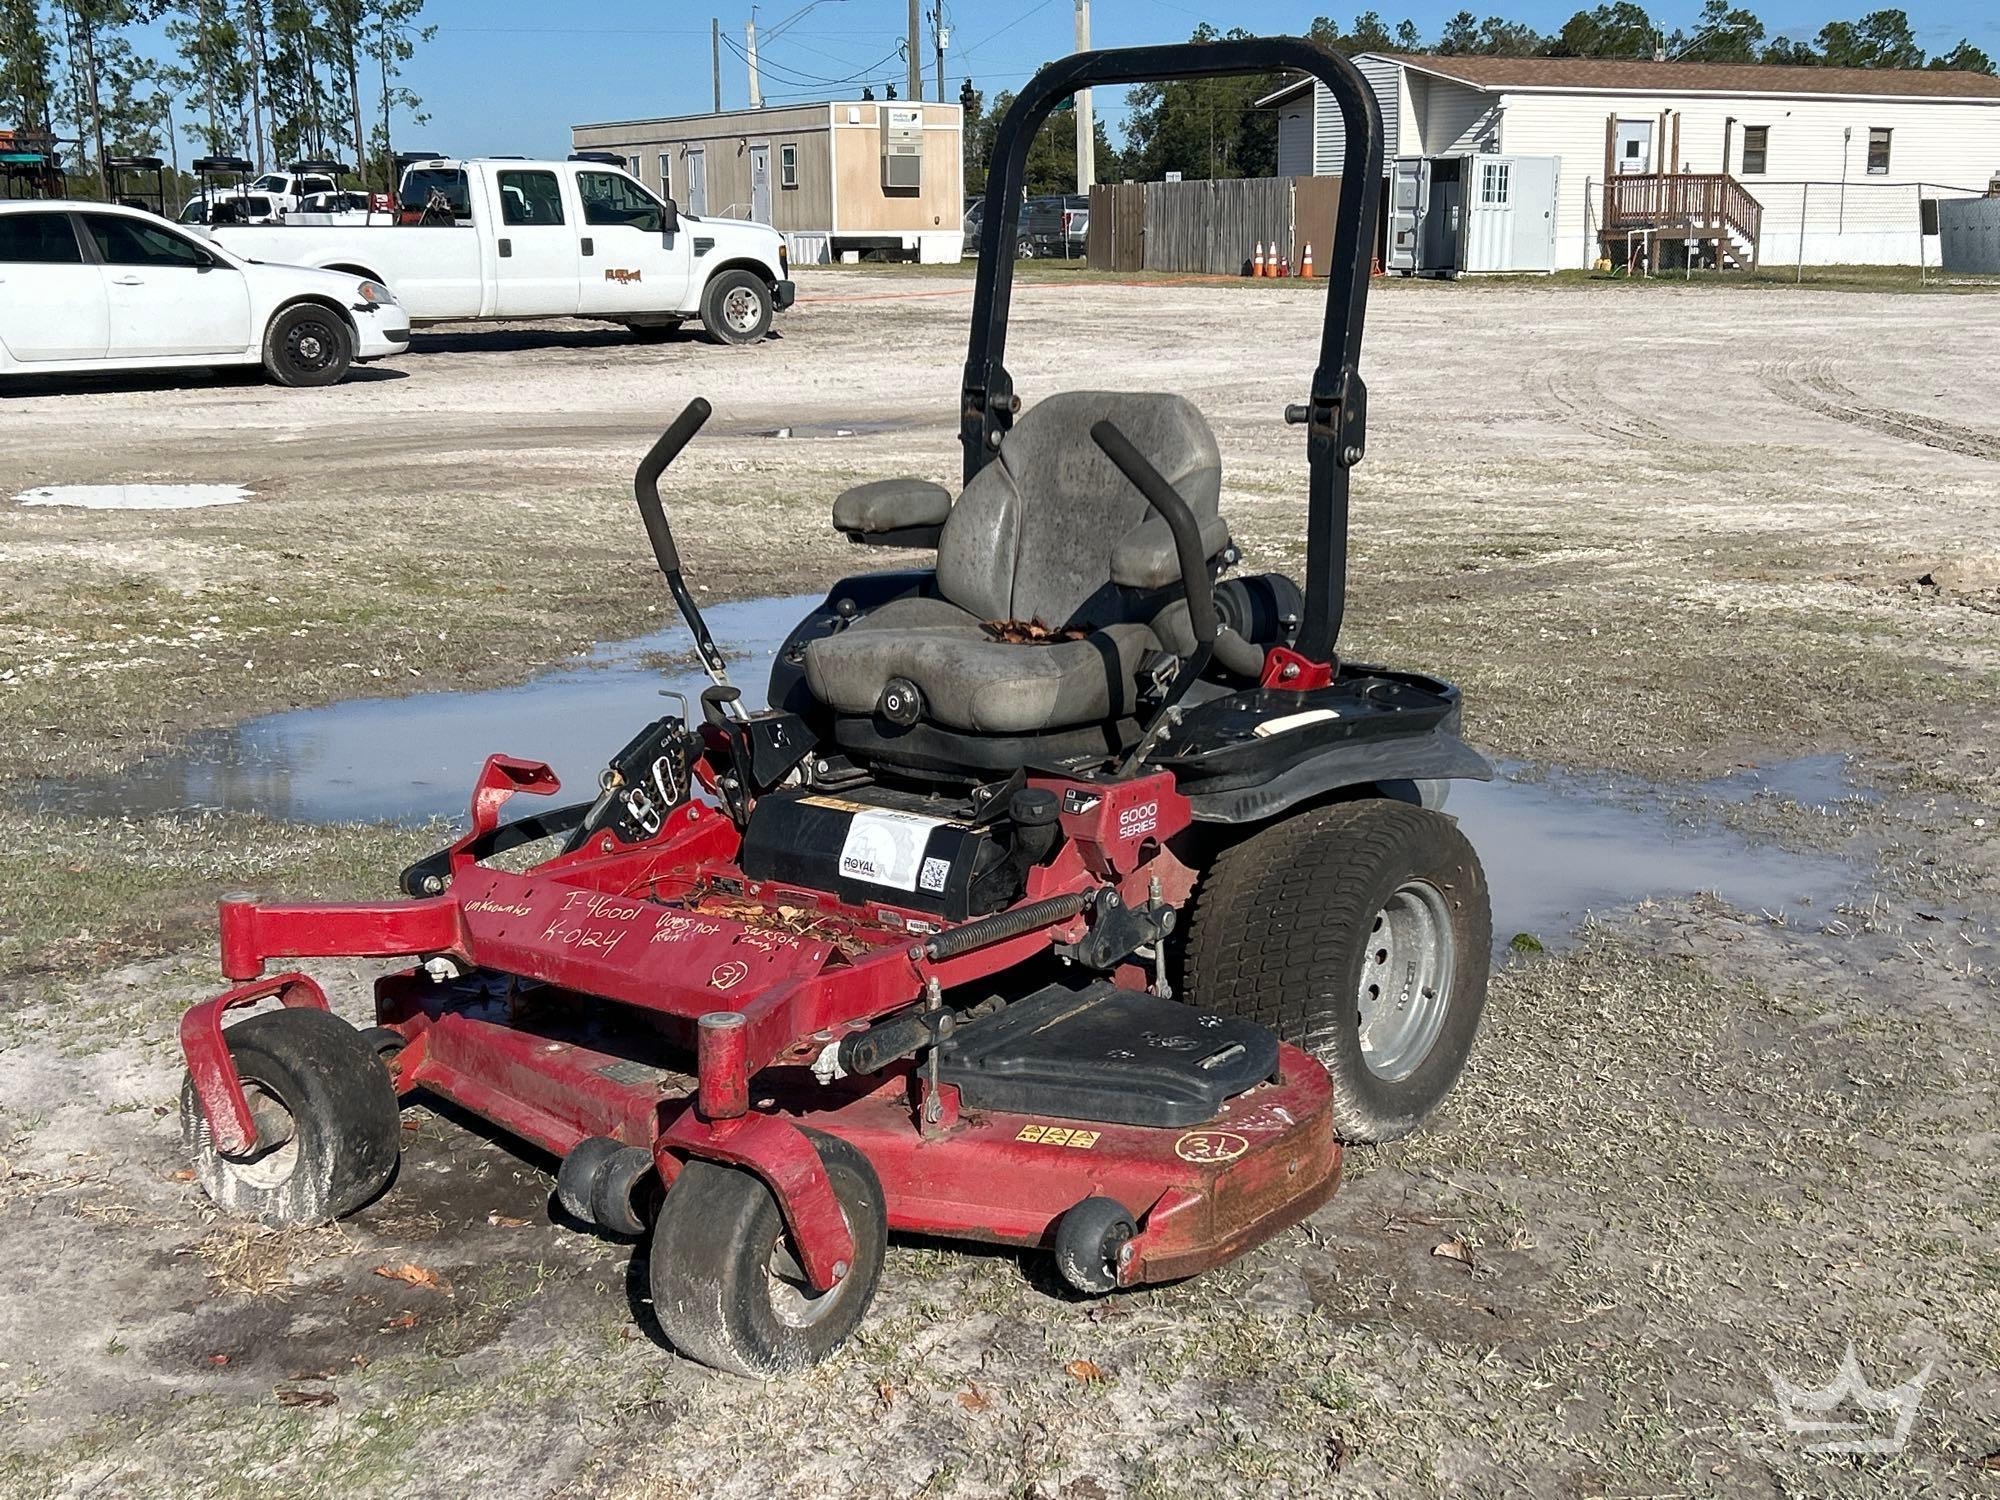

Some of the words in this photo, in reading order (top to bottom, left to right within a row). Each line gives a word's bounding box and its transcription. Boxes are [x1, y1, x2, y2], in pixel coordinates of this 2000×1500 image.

[1120, 802, 1158, 825] 6000
[1119, 818, 1157, 839] SERIES
[844, 856, 875, 873] ROYAL
[560, 891, 644, 920] I-46001
[540, 918, 627, 958] K-0124
[650, 928, 679, 943] Run
[692, 923, 720, 935] not
